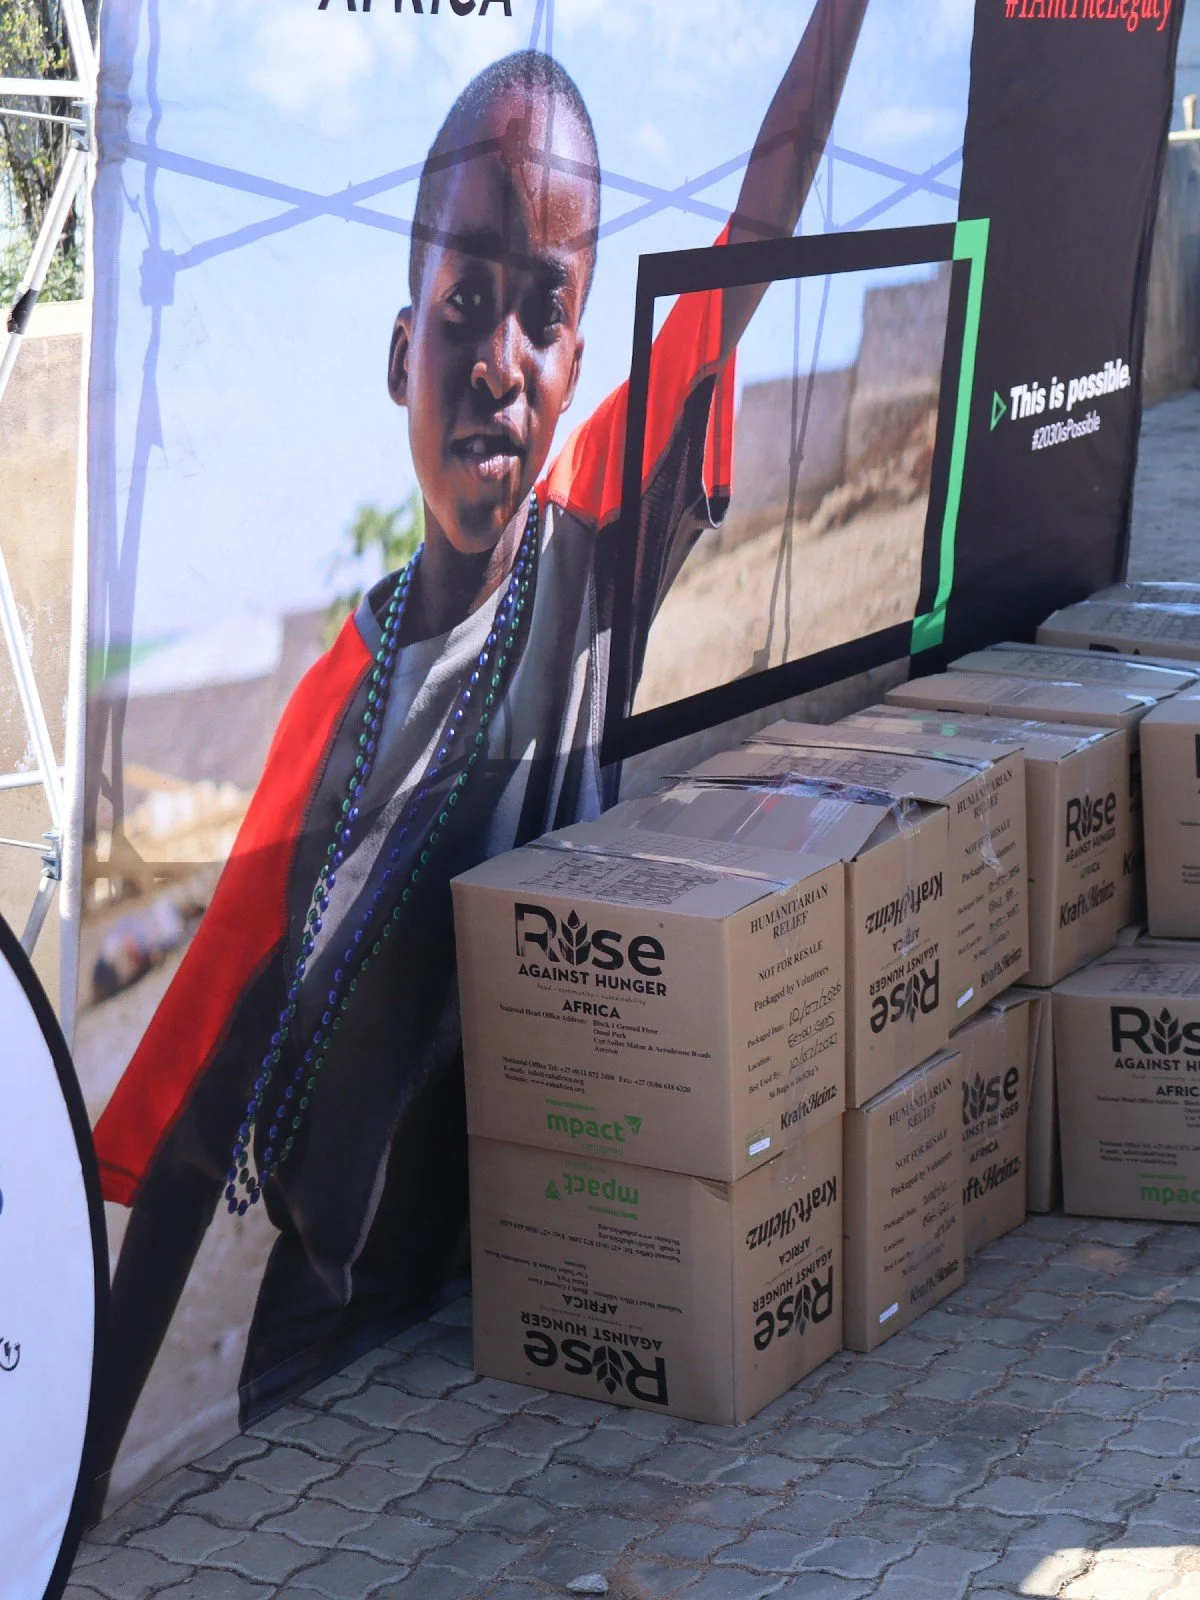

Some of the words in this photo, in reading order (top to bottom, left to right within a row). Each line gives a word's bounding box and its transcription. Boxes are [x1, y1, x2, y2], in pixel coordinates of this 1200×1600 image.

[1010, 381, 1047, 420] This
[1049, 376, 1065, 410] is
[1066, 358, 1131, 412] possible.
[1032, 409, 1101, 450] #2030isPossible
[1066, 791, 1116, 848] Rise
[750, 883, 827, 934] HUMANITARIAN
[772, 909, 808, 940] RELIEF
[514, 902, 666, 977] Rise
[907, 942, 938, 973] AGAINST
[759, 964, 775, 982] NOT
[776, 955, 792, 973] FOR
[793, 939, 822, 964] RESALE
[518, 963, 590, 985] AGAINST
[595, 973, 668, 997] HUNGER
[753, 986, 784, 1013] Packaged
[786, 981, 793, 996] by
[796, 963, 828, 990] Volunteers
[869, 964, 904, 995] HUNGER
[870, 959, 939, 1034] Rise
[562, 999, 621, 1019] AFRICA
[1113, 1056, 1180, 1071] AGAINST
[889, 1074, 951, 1127] HUMANITARIAN
[907, 1100, 936, 1130] RELIEF
[546, 1112, 626, 1144] mpact
[962, 1118, 986, 1142] INST
[987, 1100, 1020, 1130] HUNGER
[895, 1152, 909, 1171] NOT
[911, 1143, 923, 1161] FOR
[925, 1126, 947, 1151] RESALE
[969, 1140, 999, 1165] AFRICA
[563, 1172, 640, 1207] mpact
[779, 1236, 810, 1265] AFRICA
[795, 1248, 832, 1285] AGAINST
[561, 1292, 619, 1317] AFRICA
[752, 1276, 793, 1313] HUNGER
[753, 1266, 833, 1351] Rise
[519, 1310, 588, 1338] HUNGER
[590, 1325, 663, 1353] AGAINST
[522, 1329, 669, 1407] Rise
